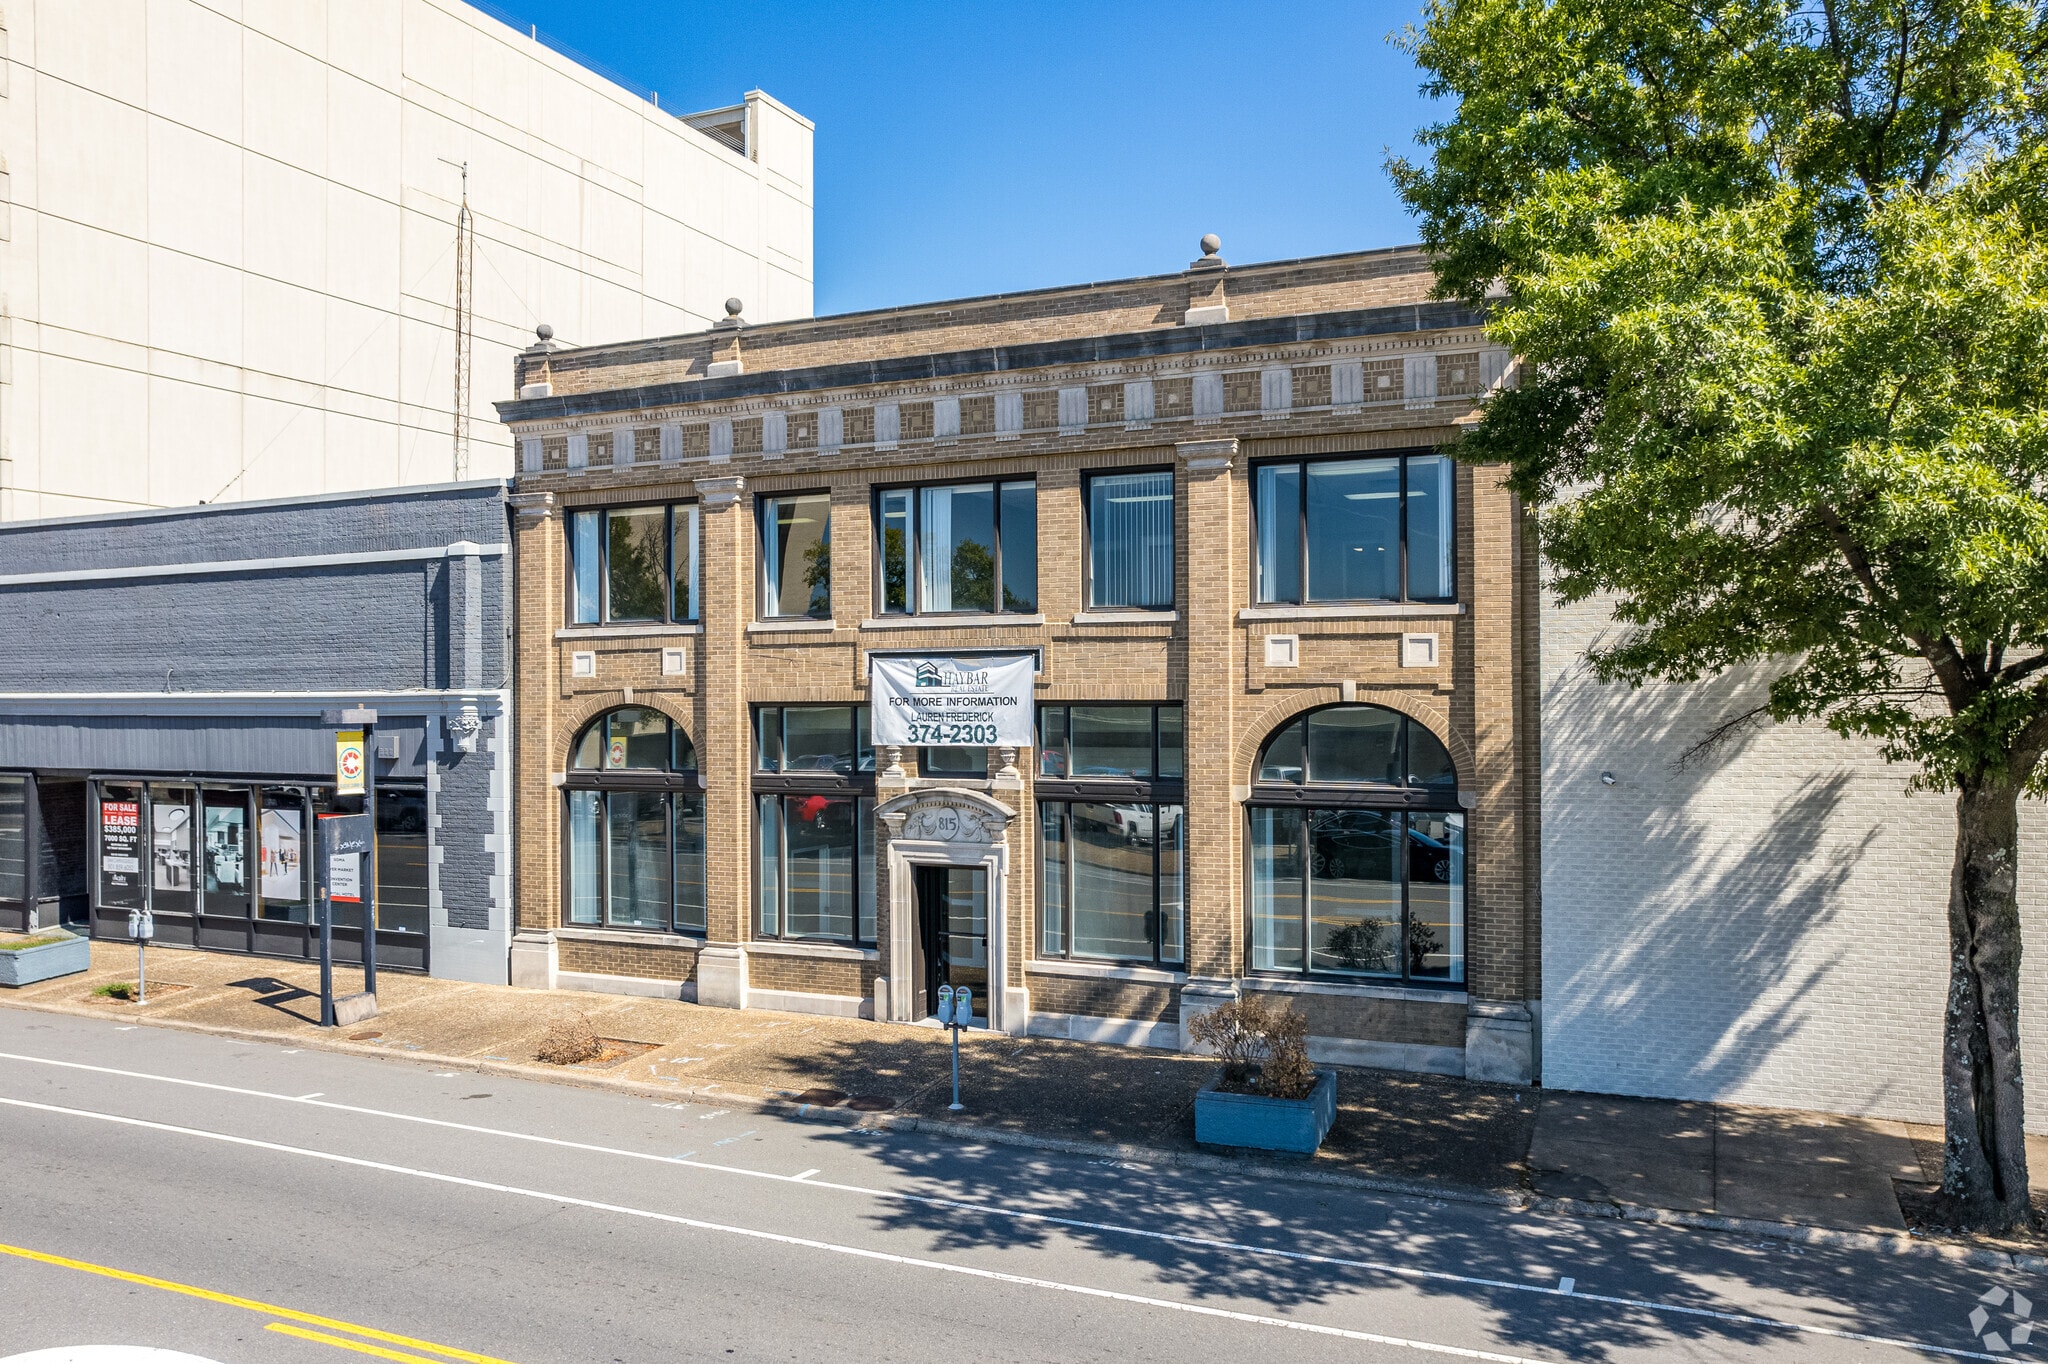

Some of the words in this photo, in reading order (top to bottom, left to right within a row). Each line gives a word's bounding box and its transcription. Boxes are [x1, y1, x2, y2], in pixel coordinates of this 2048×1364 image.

[943, 671, 988, 685] HAYBAR
[889, 697, 909, 707] FOR
[913, 697, 942, 707] MORE
[946, 696, 1018, 707] INFORMATION
[911, 712, 944, 722] LAUREN
[946, 711, 994, 722] FREDERICK
[907, 724, 998, 744] 374-2303
[104, 803, 118, 811] FOR
[119, 803, 137, 812] SALE
[104, 815, 137, 826] LEASE
[938, 817, 957, 831] 815
[104, 825, 136, 834] $385,000
[118, 835, 129, 843] SQ.
